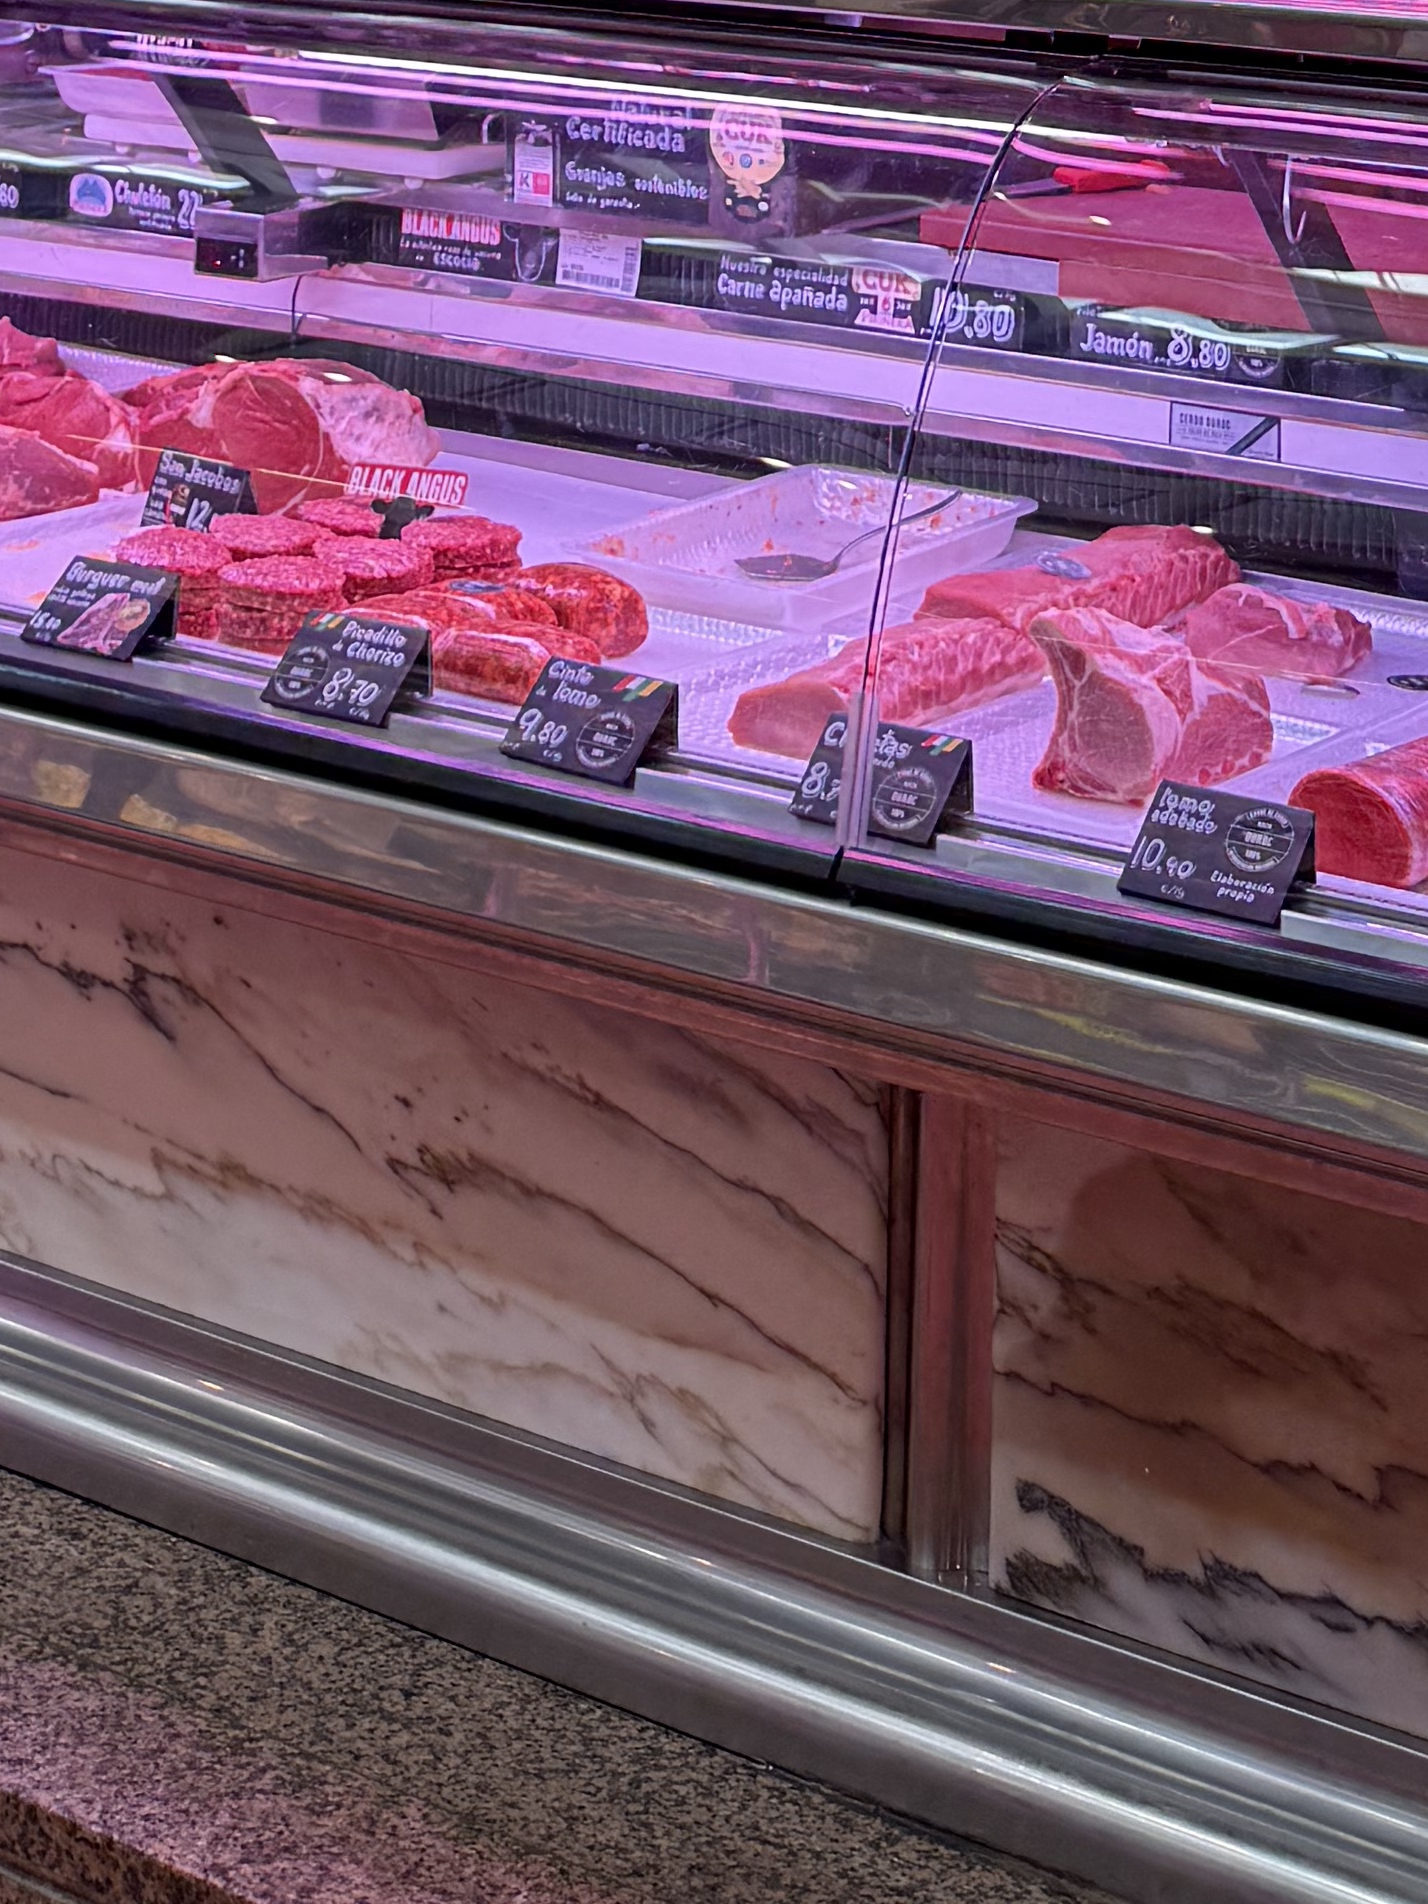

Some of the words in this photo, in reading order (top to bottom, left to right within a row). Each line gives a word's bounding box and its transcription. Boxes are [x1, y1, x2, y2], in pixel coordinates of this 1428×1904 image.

[566, 116, 685, 152] Certificada
[565, 161, 625, 190] Granjas
[402, 209, 445, 238] BLACK
[449, 213, 500, 245] ANGUS
[717, 275, 764, 299] Carne
[774, 267, 848, 287] especialidad
[1080, 324, 1153, 359] Jamón
[349, 466, 406, 498] BLACK
[406, 472, 466, 504] ANGUS
[342, 620, 406, 647] Picadillo
[347, 641, 406, 667] Chorizo
[1211, 870, 1275, 895] Elaboración
[1217, 886, 1255, 902] propia
